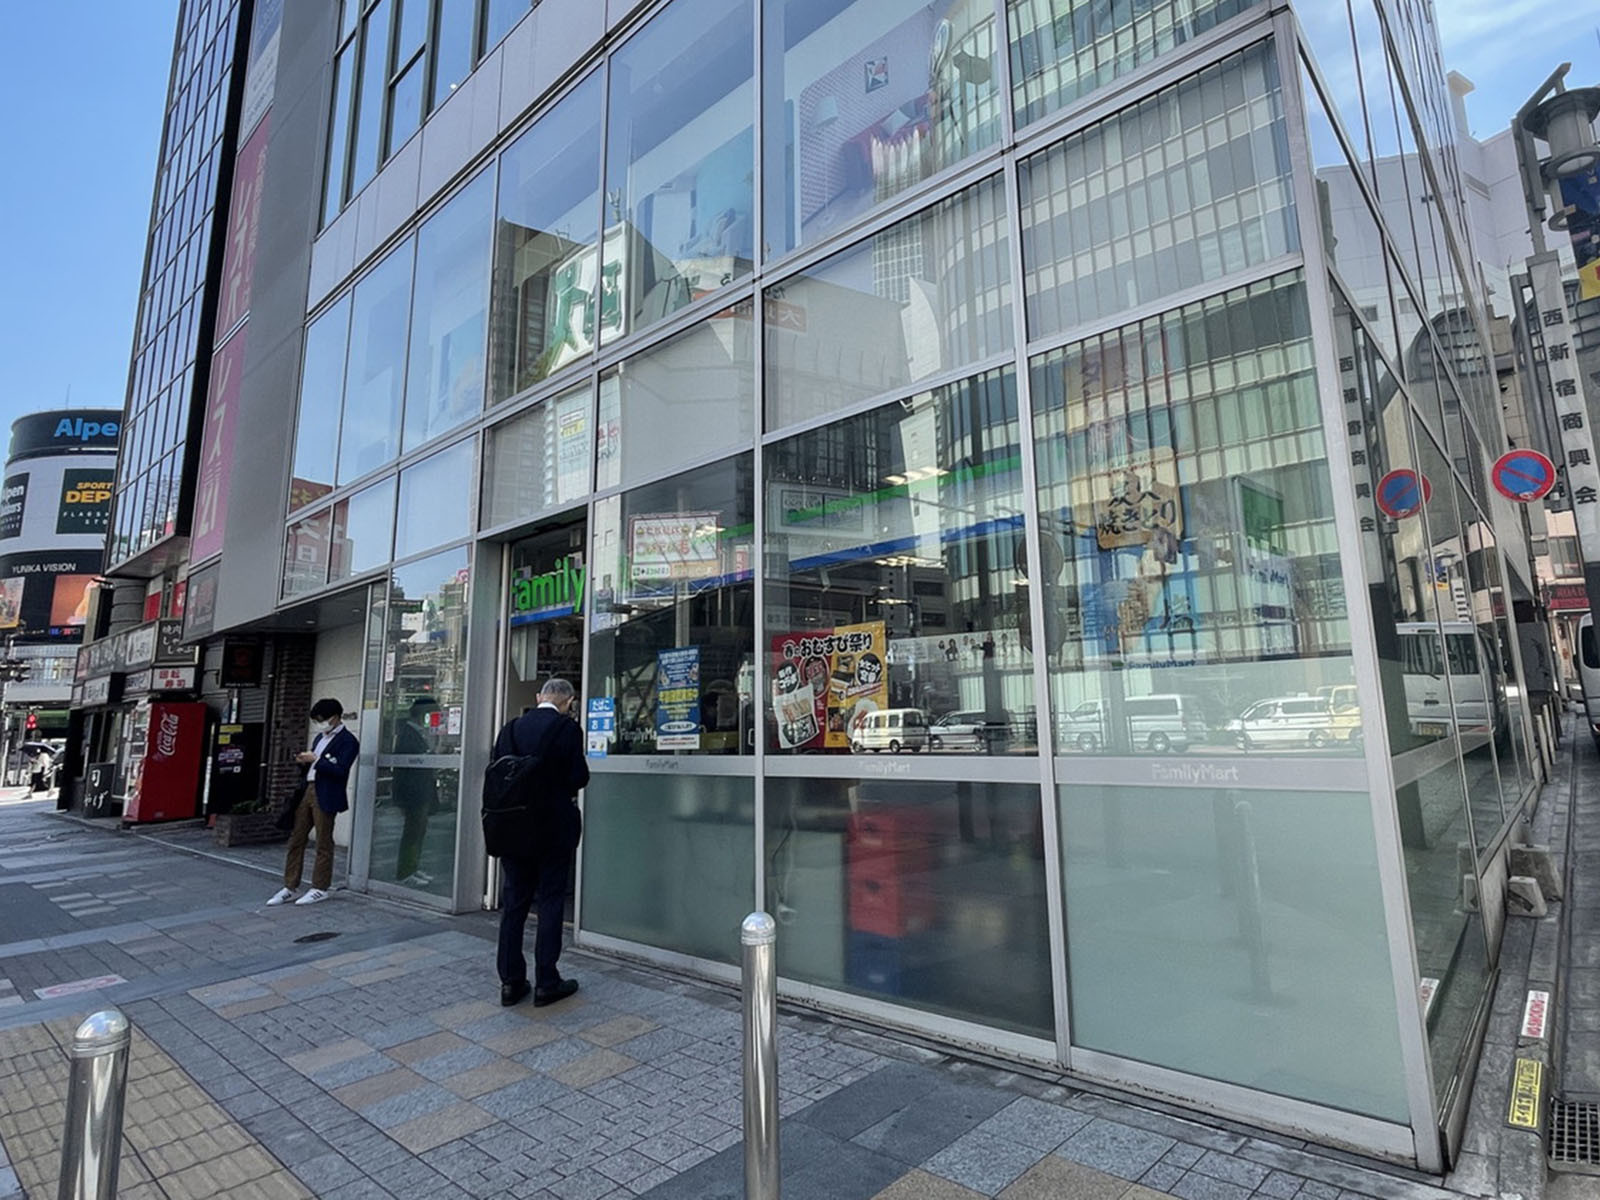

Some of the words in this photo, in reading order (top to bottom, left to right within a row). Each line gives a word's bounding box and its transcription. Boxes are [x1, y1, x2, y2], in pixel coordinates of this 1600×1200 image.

[1541, 307, 1597, 505] 西新宿商興会
[54, 417, 119, 441] Alpe
[65, 490, 111, 504] DEP
[42, 563, 76, 572] VISION
[1128, 658, 1196, 669] FamilyMart
[1151, 764, 1239, 783] FamilyMart
